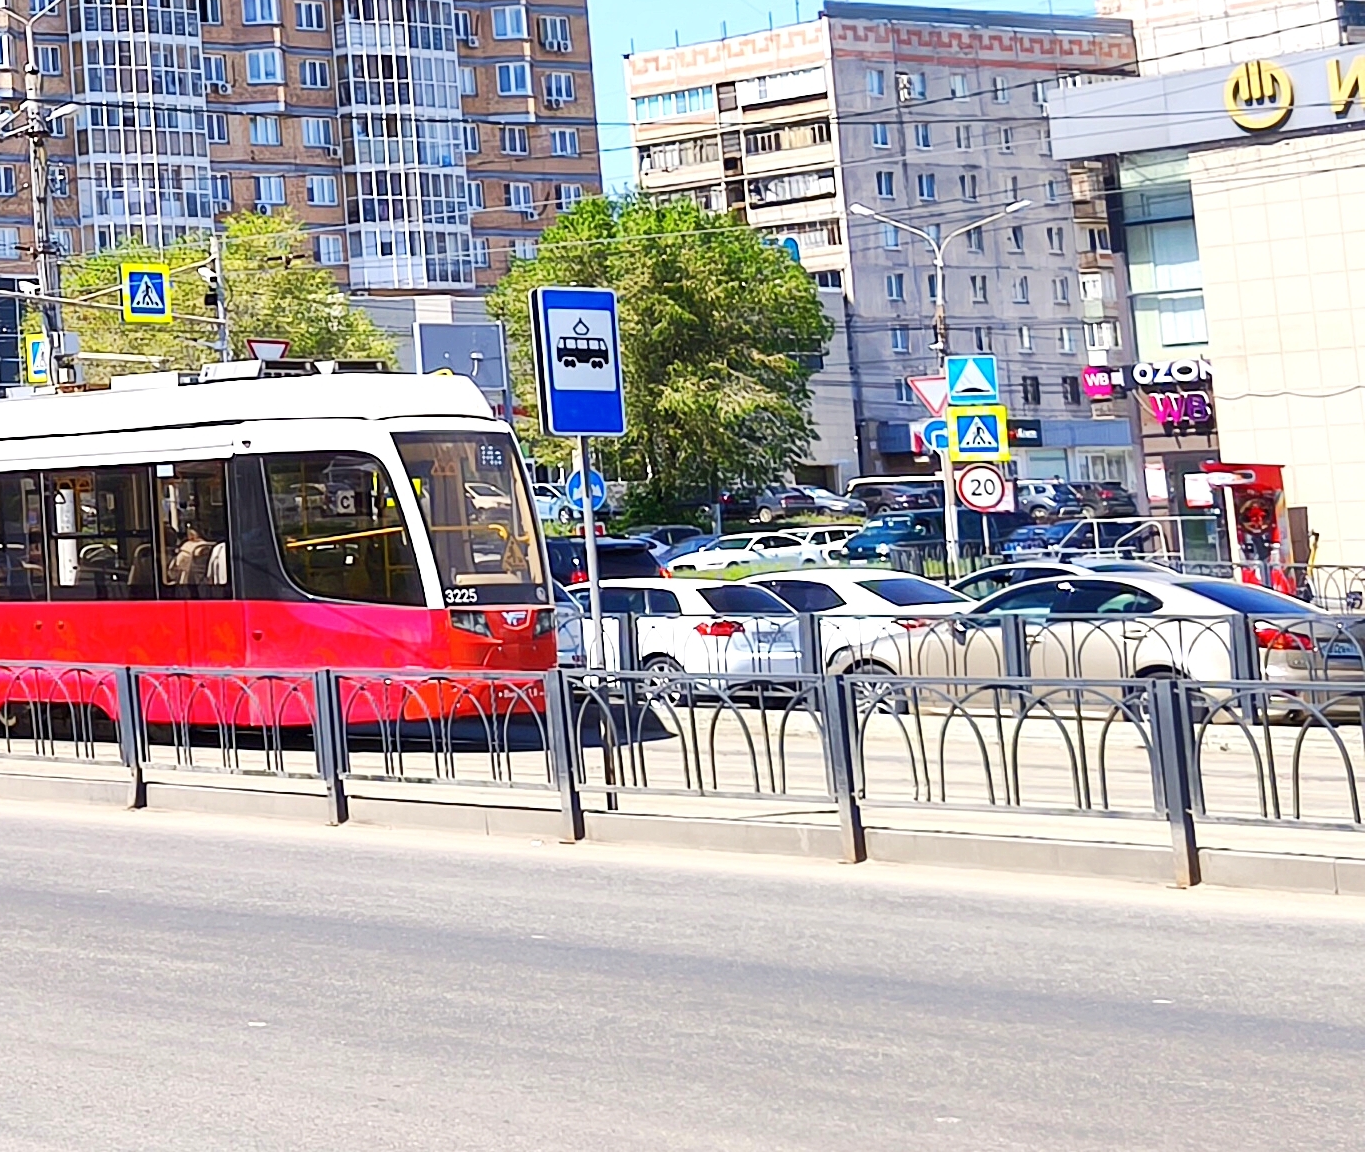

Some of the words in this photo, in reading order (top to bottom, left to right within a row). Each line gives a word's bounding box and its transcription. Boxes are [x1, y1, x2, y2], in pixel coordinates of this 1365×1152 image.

[1084, 372, 1109, 387] WB
[1149, 391, 1211, 425] WB
[970, 478, 996, 496] 20
[445, 589, 478, 604] 3225
